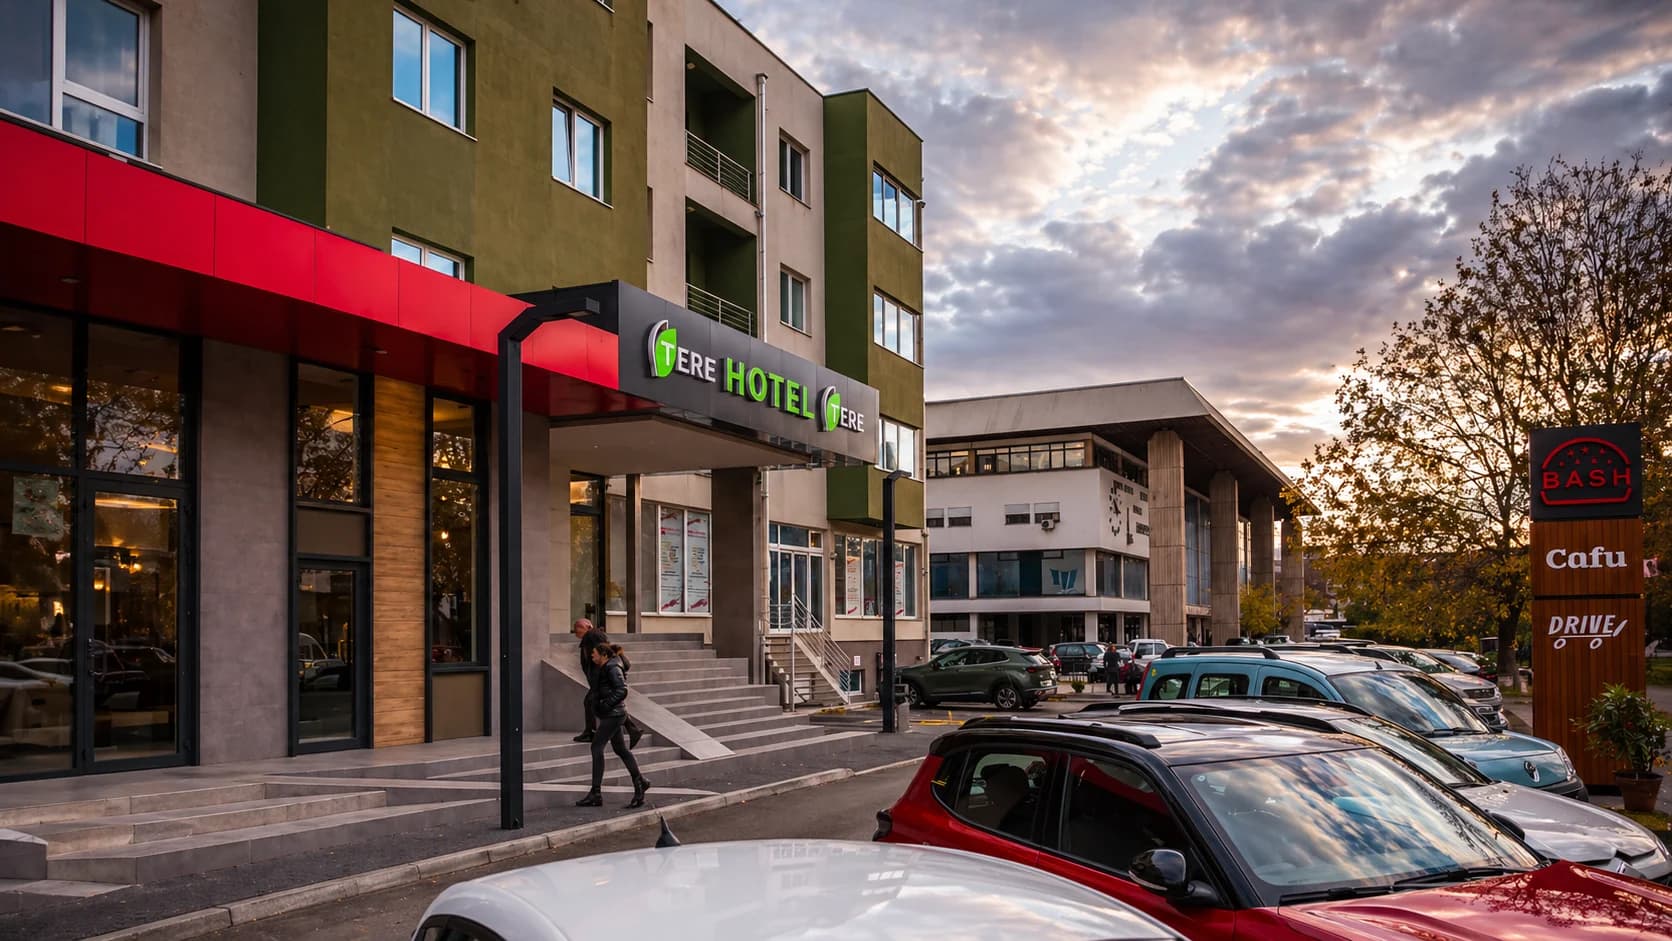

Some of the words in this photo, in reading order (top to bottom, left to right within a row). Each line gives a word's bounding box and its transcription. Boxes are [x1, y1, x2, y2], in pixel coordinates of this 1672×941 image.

[661, 341, 716, 382] TERE
[726, 357, 815, 419] HOTEL
[831, 404, 864, 432] TERE
[1543, 468, 1631, 489] BASH
[1546, 547, 1627, 569] Cafu
[1548, 615, 1616, 635] DRIVE
